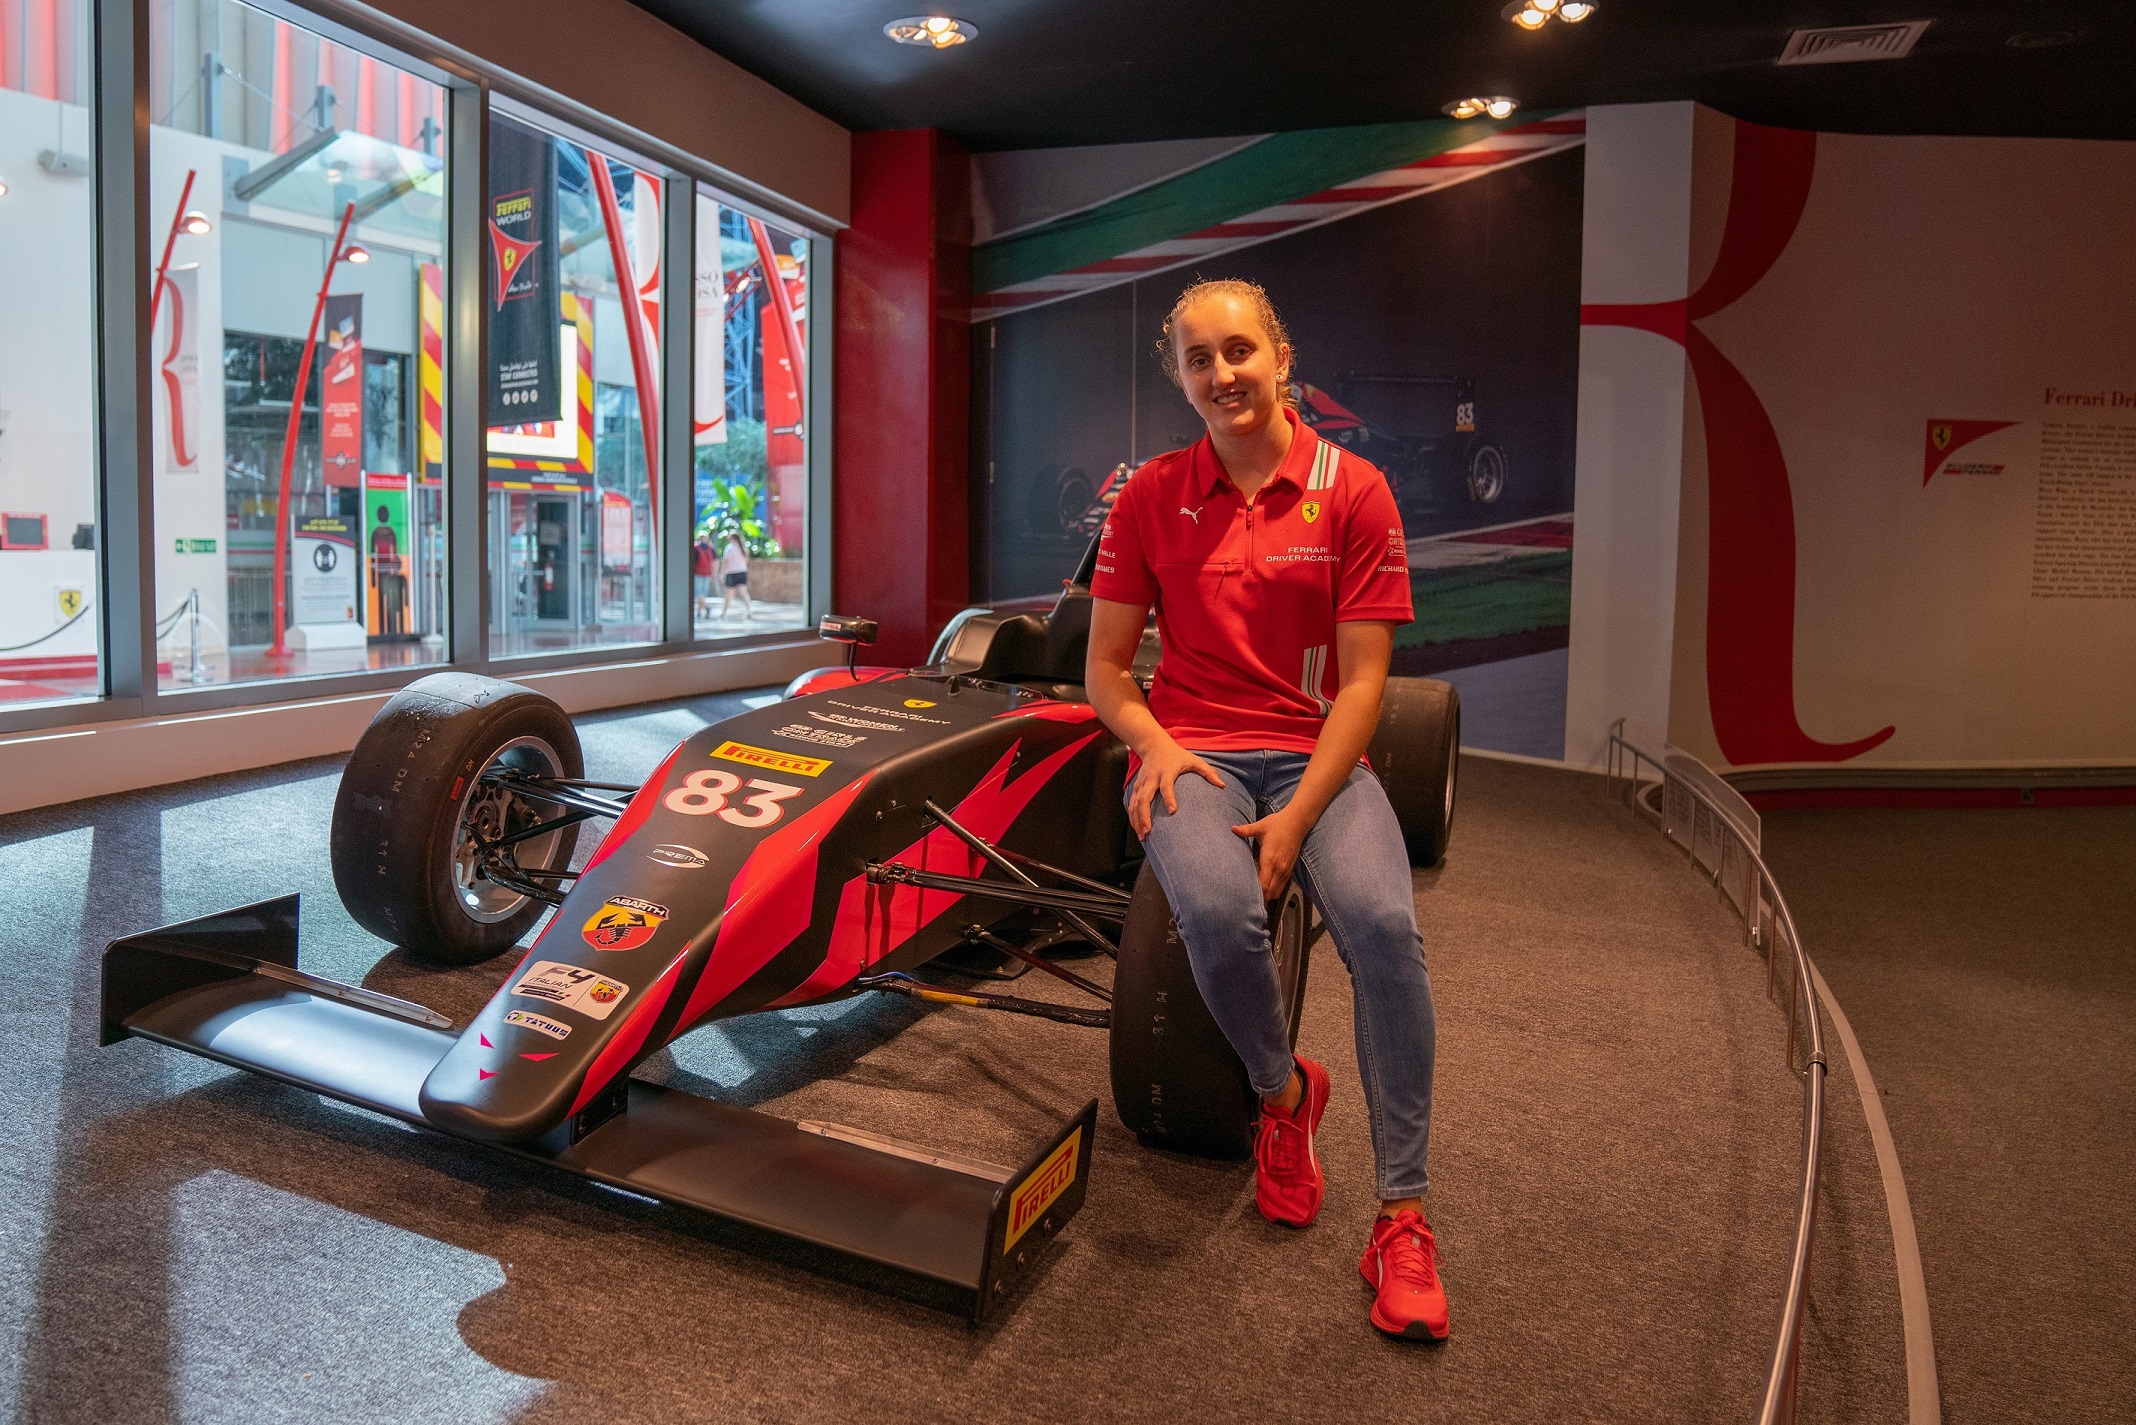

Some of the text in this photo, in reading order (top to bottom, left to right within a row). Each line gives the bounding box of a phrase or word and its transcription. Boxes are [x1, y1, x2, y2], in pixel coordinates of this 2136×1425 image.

[496, 210, 531, 226] WORLD
[2044, 386, 2105, 407] Ferrari
[1455, 401, 1474, 425] 83
[1287, 546, 1328, 554] FERRARI
[1302, 555, 1340, 563] ACADEMY
[1377, 565, 1404, 573] RICHARD
[723, 745, 820, 771] PIRELLI
[661, 769, 805, 829] 83
[653, 848, 706, 866] PREMA
[609, 897, 666, 917] ABARTH
[528, 976, 573, 989] ITALIAN
[538, 965, 596, 984] F4
[525, 1016, 569, 1037] TATUUS
[1012, 1144, 1074, 1235] PIRELLI
